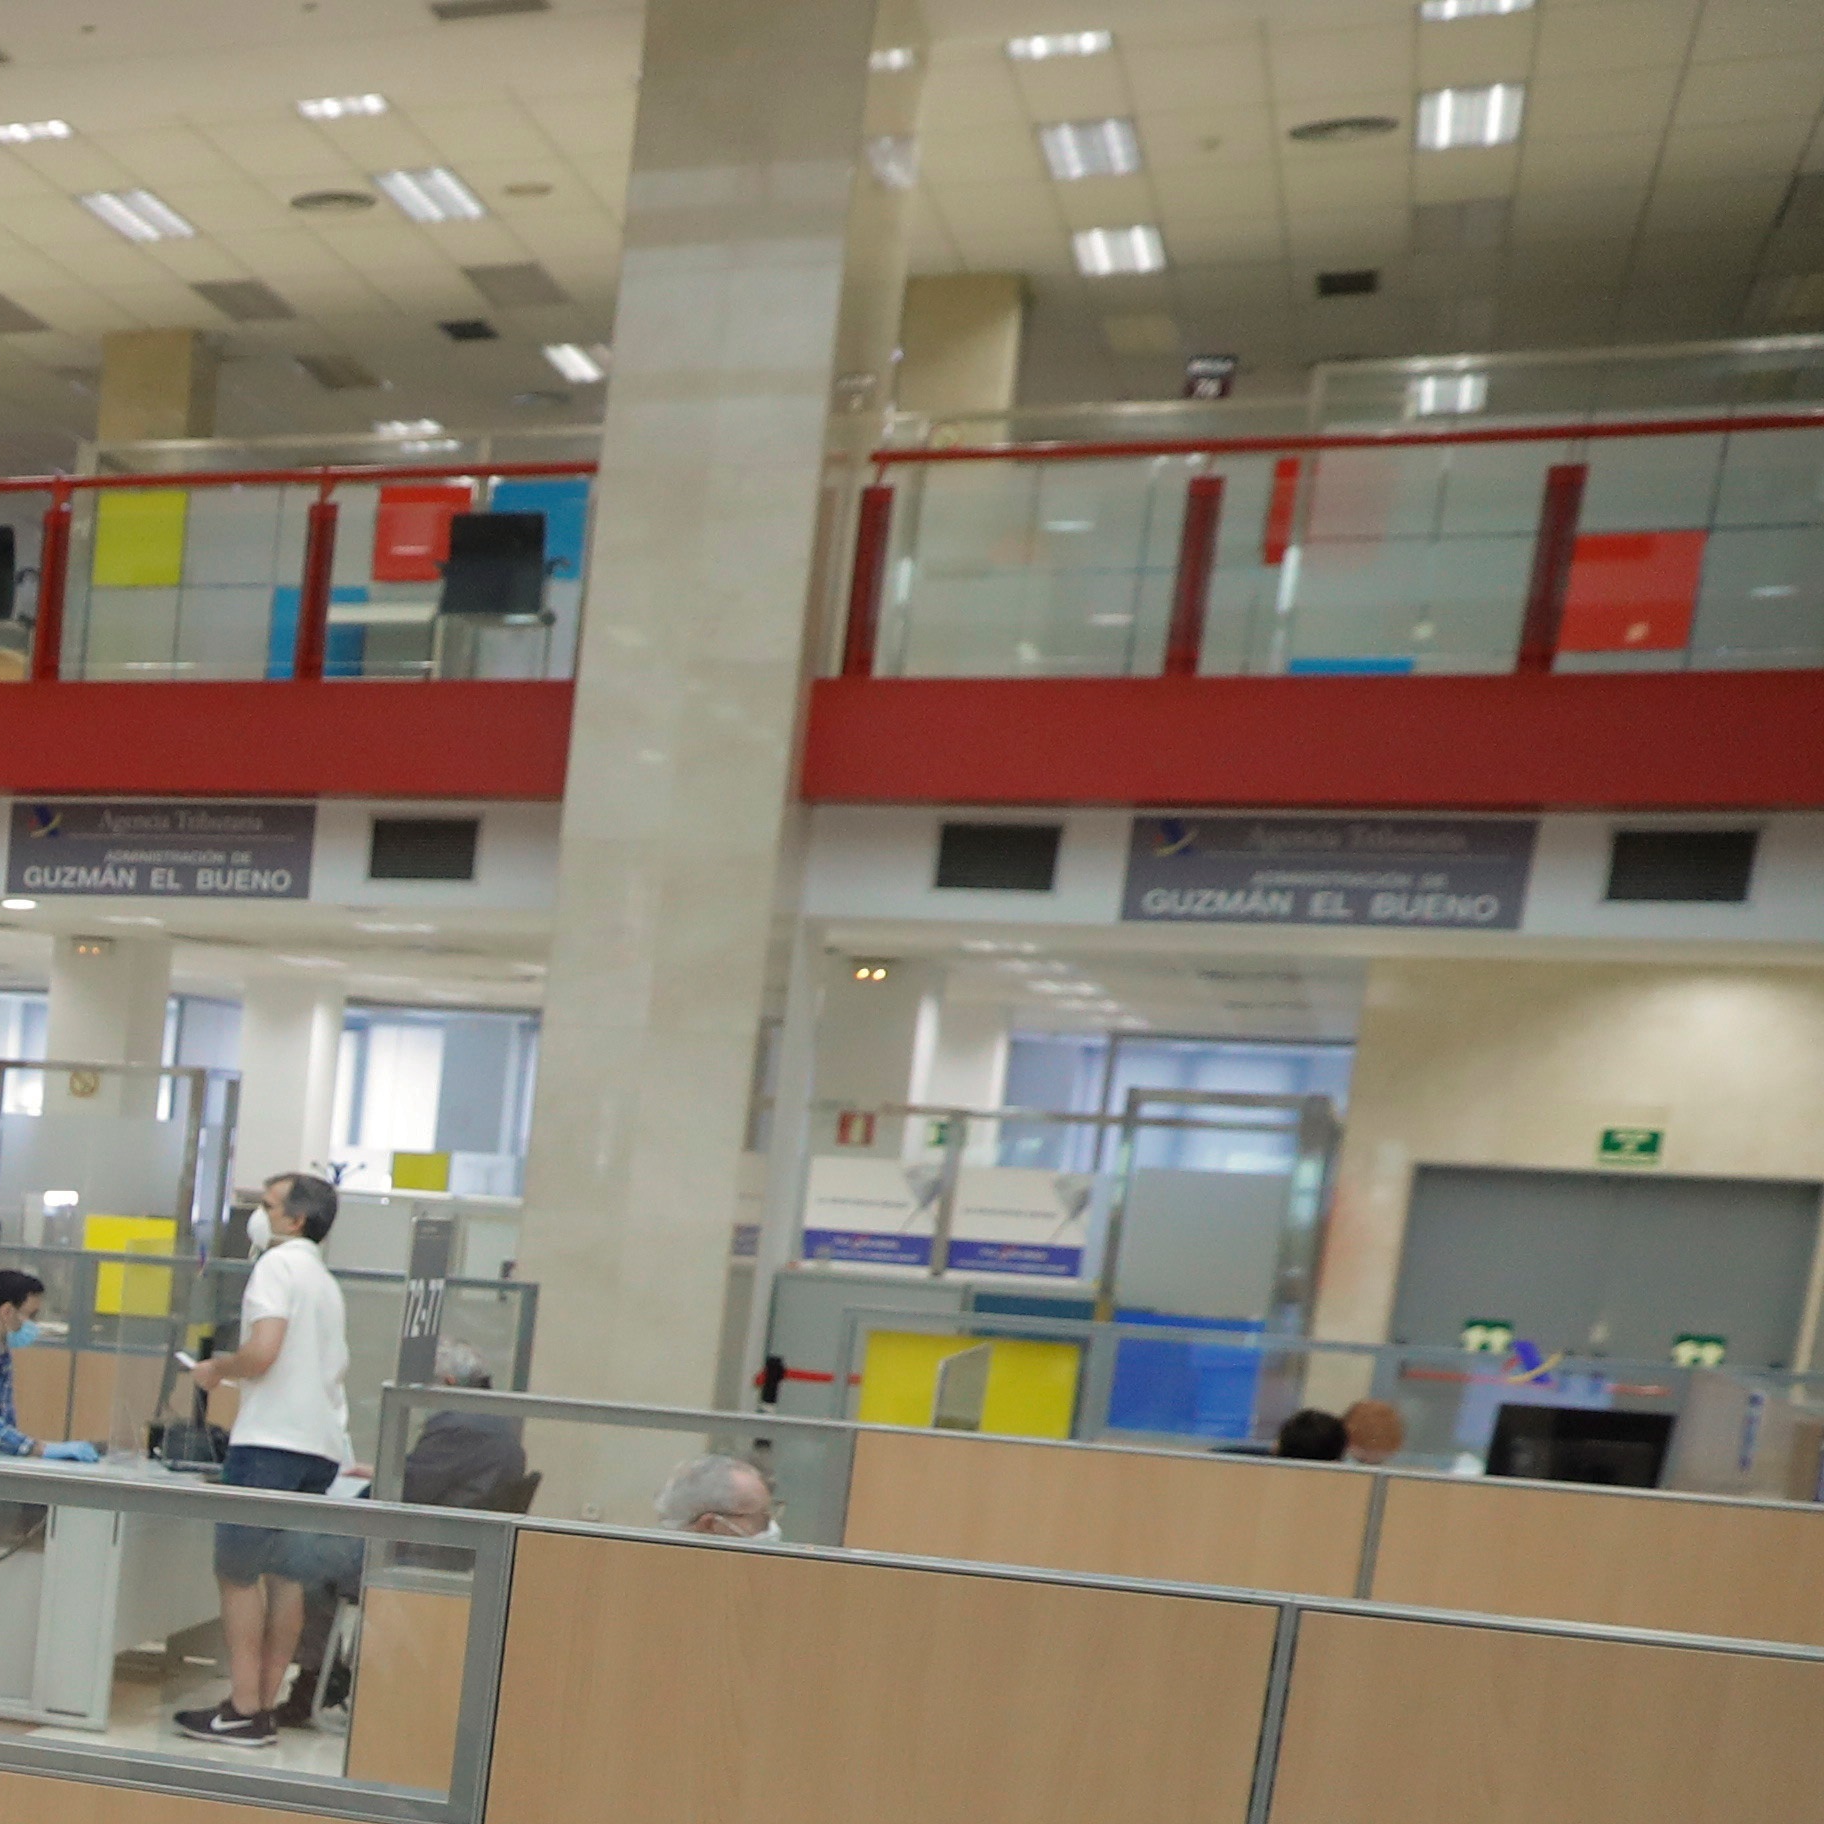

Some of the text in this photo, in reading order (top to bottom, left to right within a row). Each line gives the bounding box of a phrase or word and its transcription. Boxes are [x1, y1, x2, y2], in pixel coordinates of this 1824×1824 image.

[23, 862, 293, 892] GUZMÁN EL BUENO
[1307, 890, 1352, 918] EL
[1369, 893, 1501, 923] BUENO
[403, 1278, 445, 1338] 72-77
